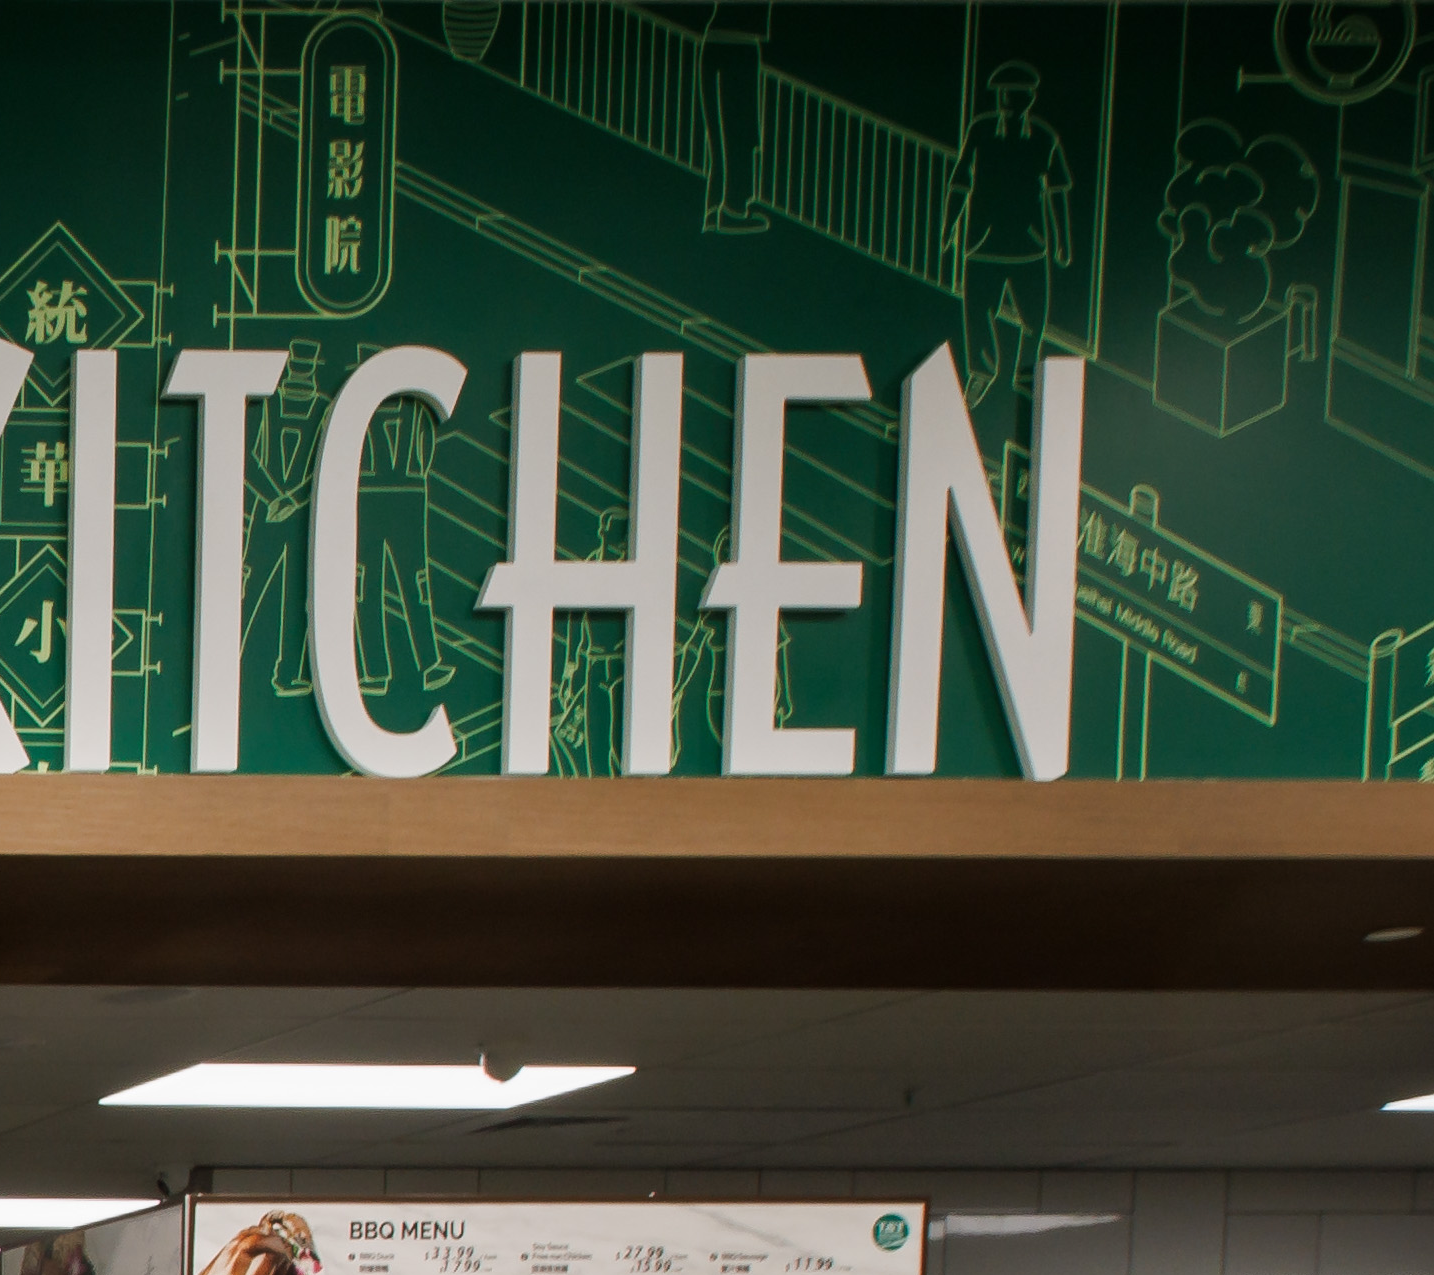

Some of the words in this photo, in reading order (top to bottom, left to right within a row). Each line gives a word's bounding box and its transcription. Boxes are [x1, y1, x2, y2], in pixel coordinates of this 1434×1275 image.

[323, 64, 367, 277] 電影院
[349, 1220, 395, 1241] BBQ
[400, 1220, 466, 1241] MENU
